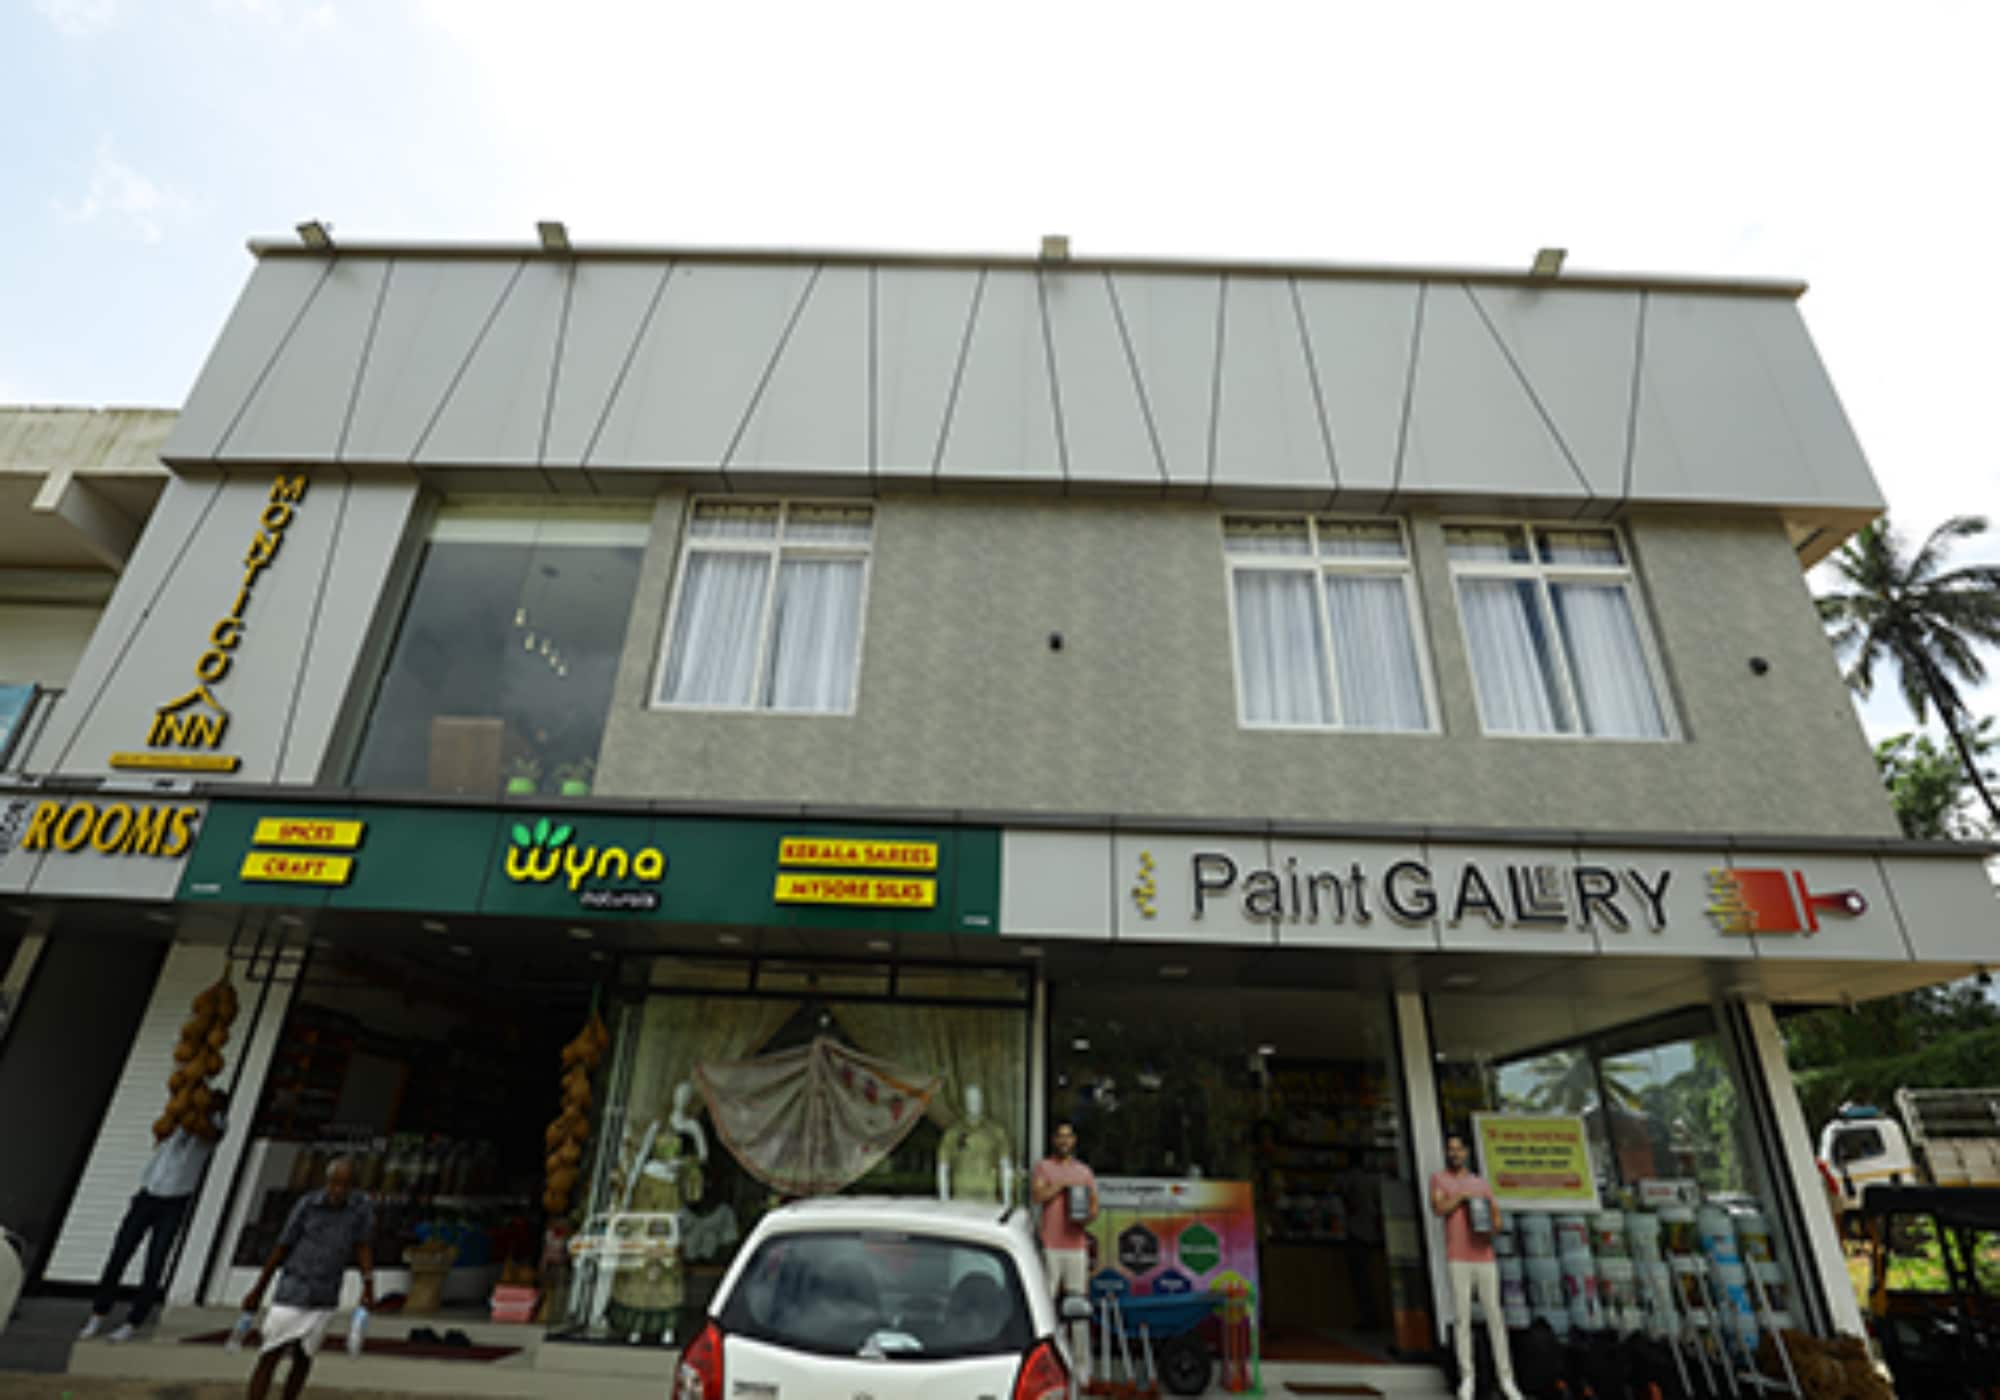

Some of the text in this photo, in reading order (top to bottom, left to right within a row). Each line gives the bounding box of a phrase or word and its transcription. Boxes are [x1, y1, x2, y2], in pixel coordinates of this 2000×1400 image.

[146, 711, 229, 748] INN
[21, 800, 199, 857] ROOMS
[278, 822, 335, 842] SPICES
[783, 842, 931, 865] KERALA SAREES
[261, 857, 329, 878] CRAFT
[791, 879, 870, 898] MYSORE
[1192, 853, 1373, 925] Paint
